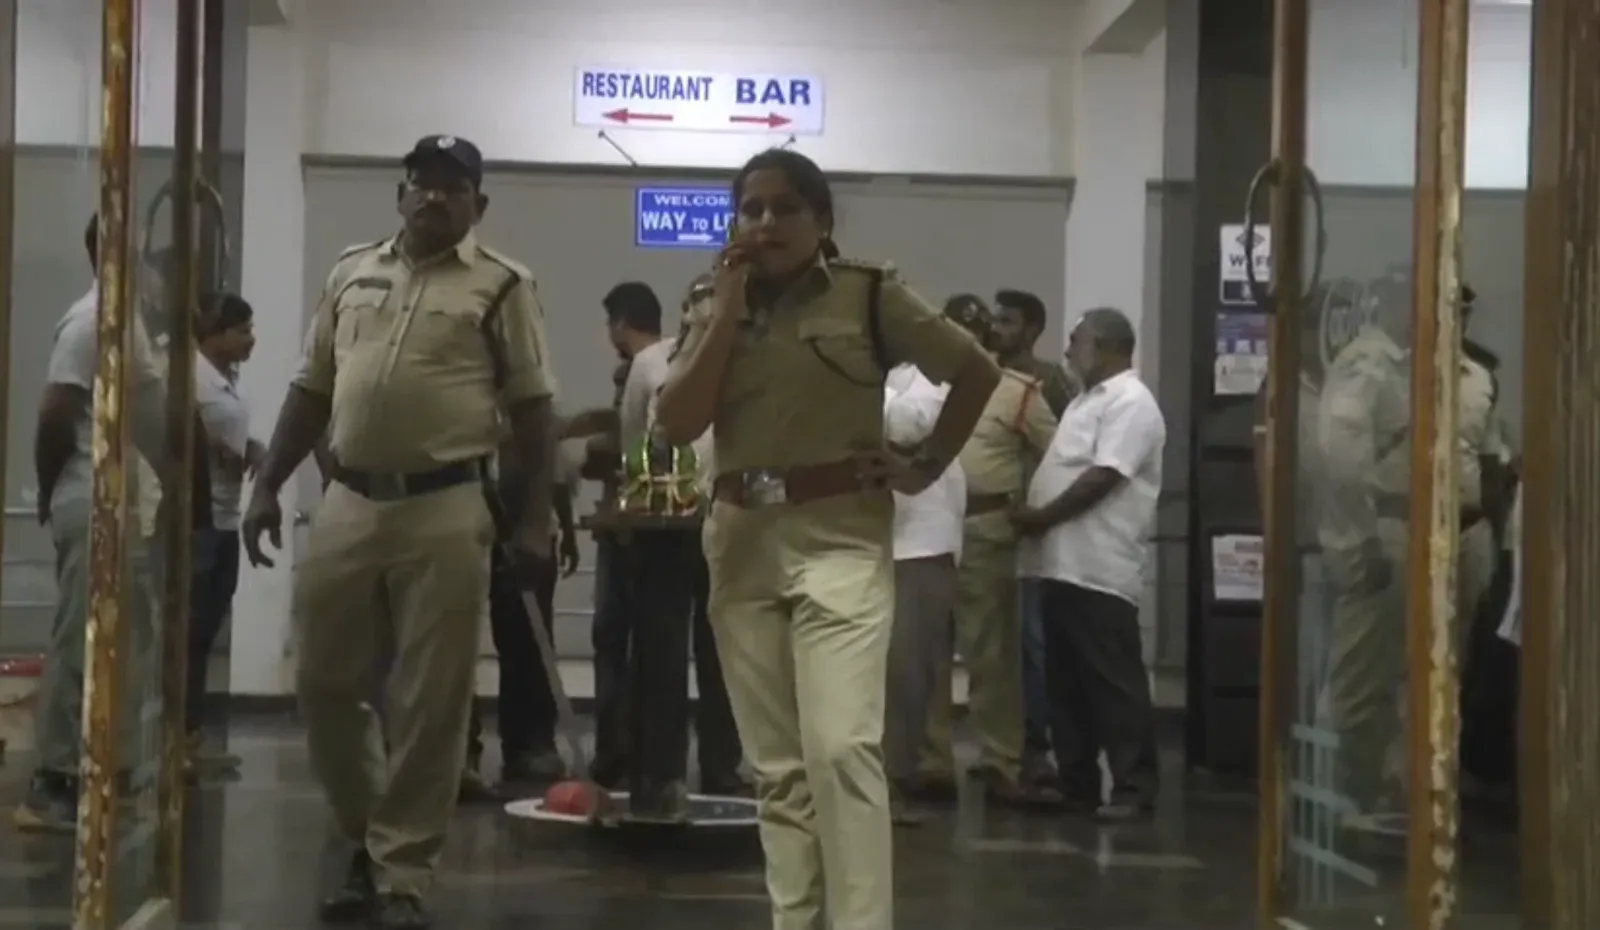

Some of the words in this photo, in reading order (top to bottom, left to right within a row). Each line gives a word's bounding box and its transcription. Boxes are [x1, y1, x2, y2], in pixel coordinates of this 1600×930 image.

[582, 71, 713, 101] RESTAURANT
[735, 77, 811, 105] BAR
[653, 193, 731, 206] WELCOM
[642, 210, 686, 231] WAY
[692, 216, 708, 231] TO
